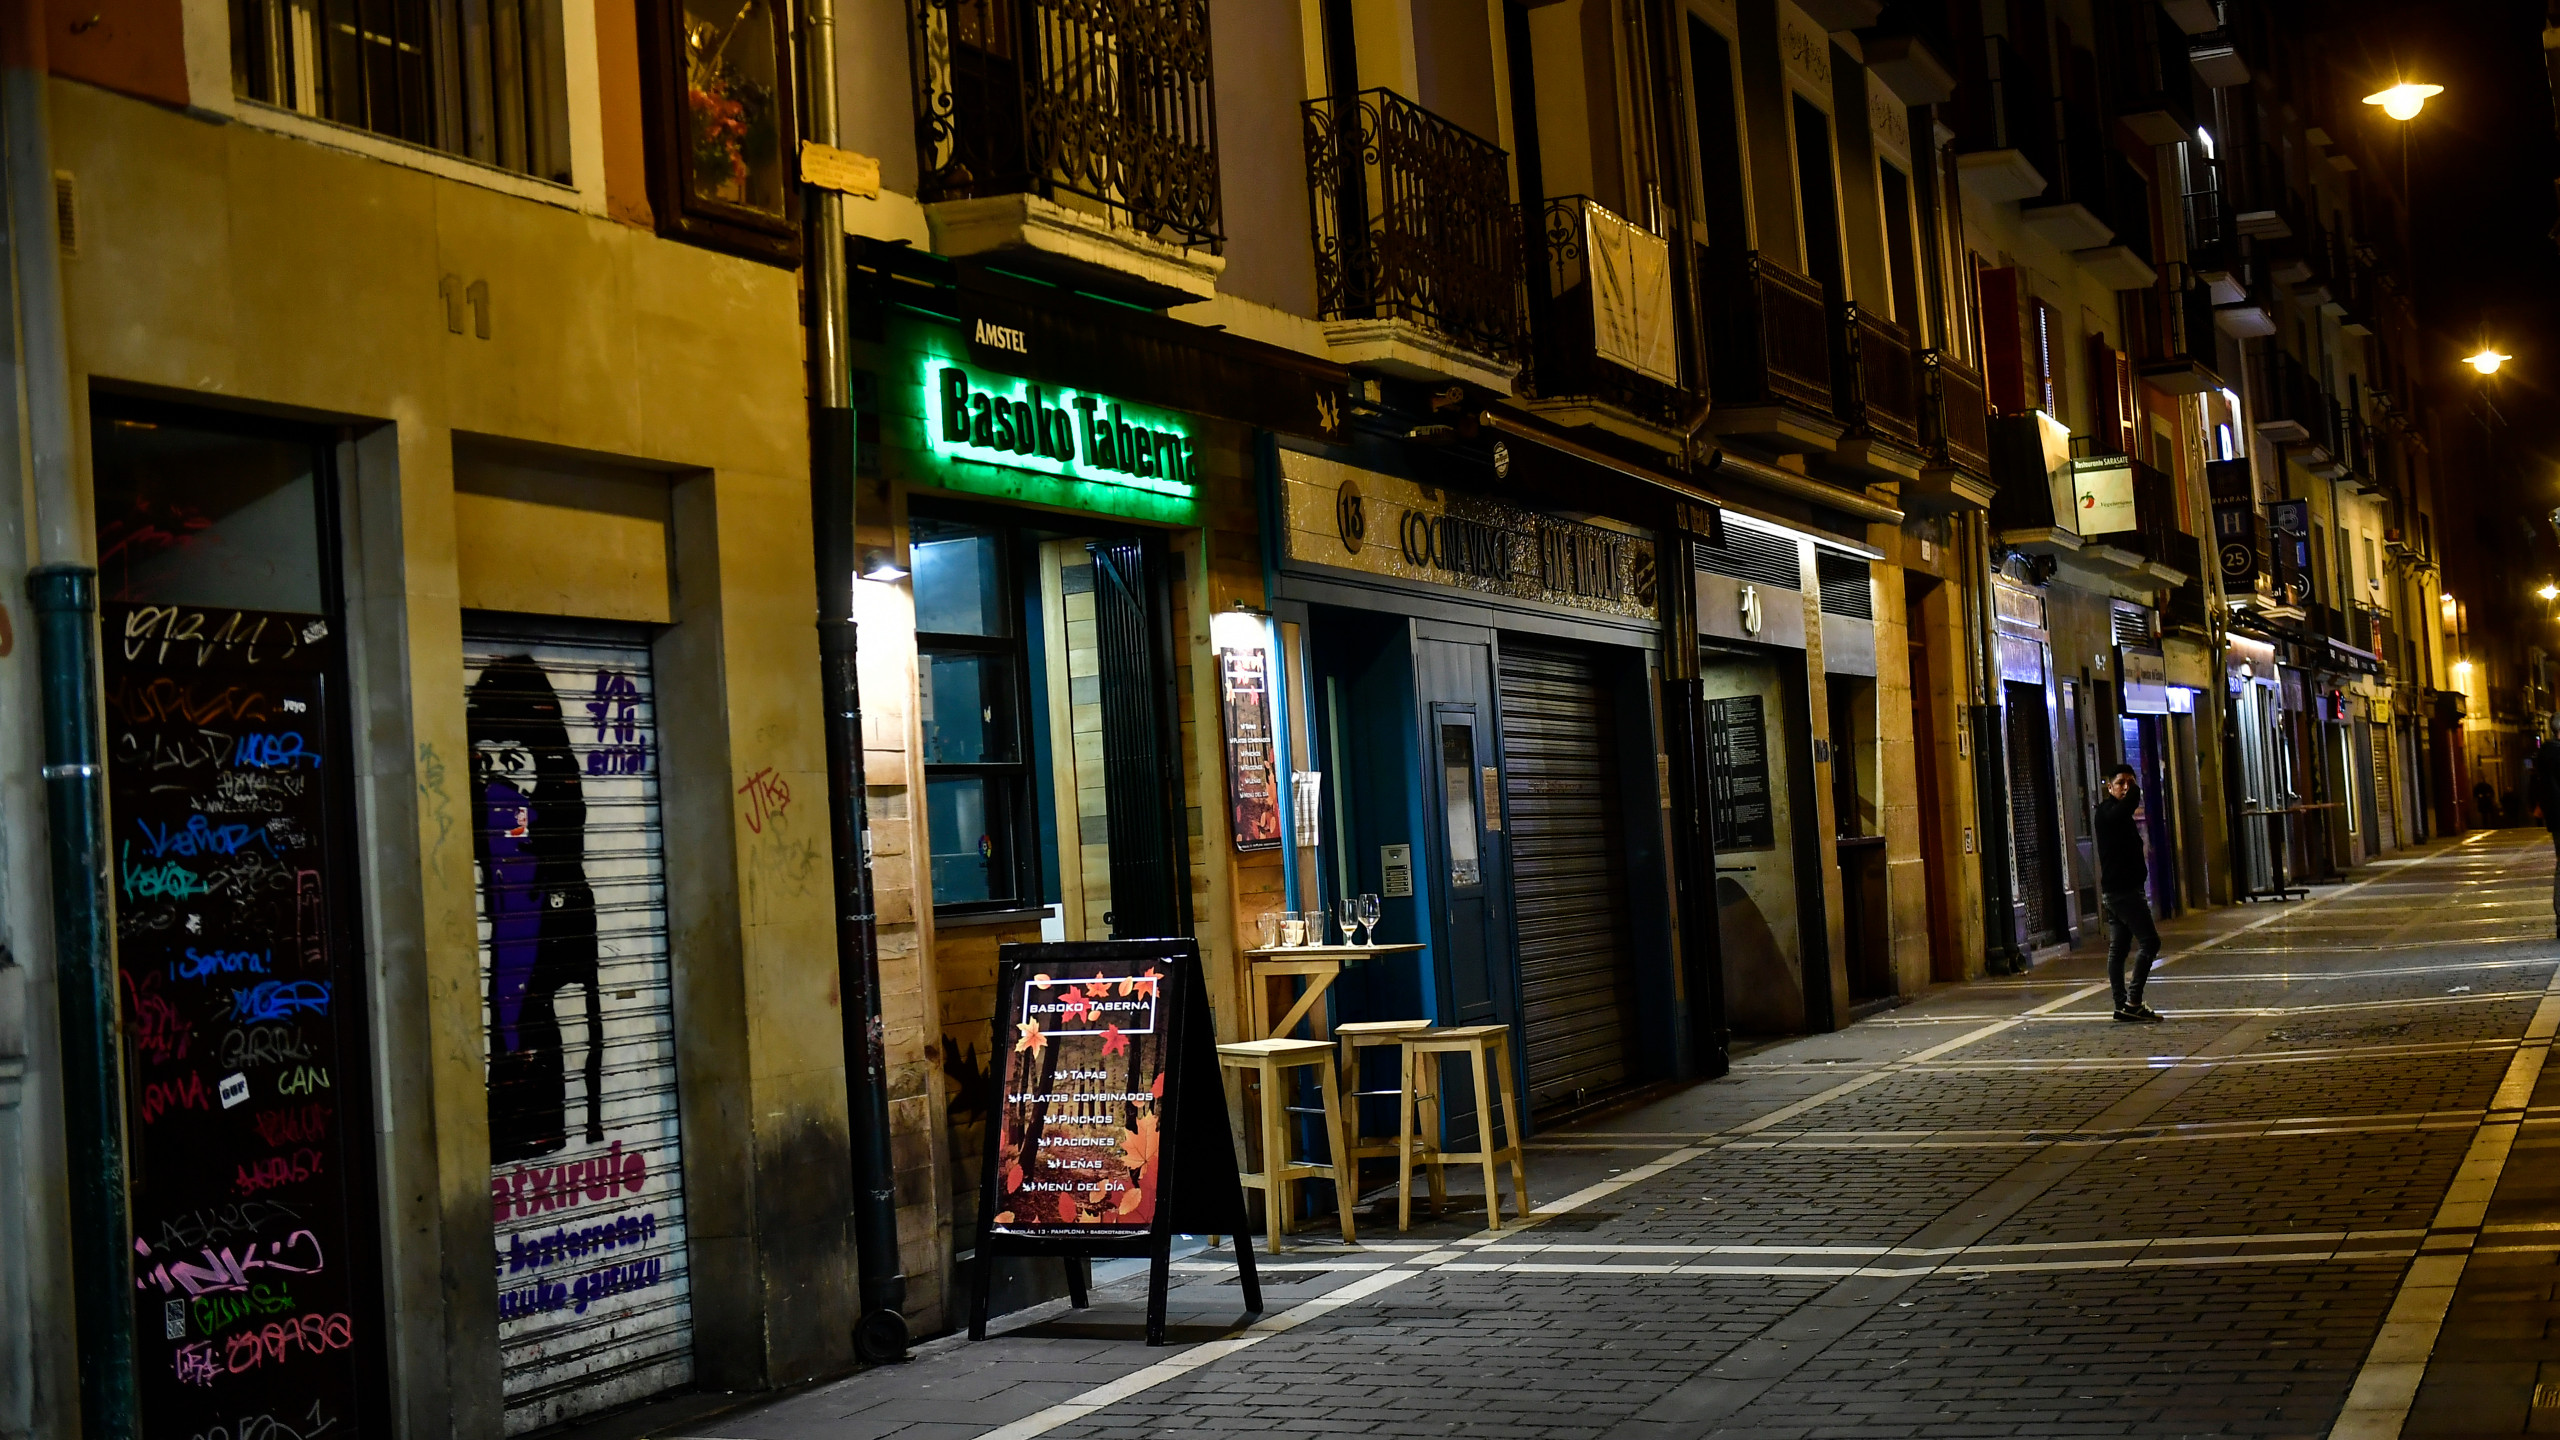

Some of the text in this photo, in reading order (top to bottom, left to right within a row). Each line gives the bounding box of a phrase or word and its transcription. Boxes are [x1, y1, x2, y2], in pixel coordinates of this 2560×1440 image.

[439, 273, 490, 340] 11
[975, 318, 1028, 354] AMSTEL
[939, 366, 1198, 486] Basoko Taberna
[1340, 494, 1364, 539] 13
[2225, 552, 2246, 568] 25
[1029, 1000, 1151, 1014] BASOKO TABERNA
[278, 1064, 331, 1096] CAN
[1070, 1070, 1108, 1081] TAPAS
[1022, 1091, 1154, 1103] PLATOS COMBINADOS
[1058, 1114, 1114, 1125] PINCHOS
[1053, 1136, 1115, 1147] RACIONES
[1062, 1158, 1103, 1170] LEÑAS
[1037, 1179, 1126, 1192] MENÚ DEL DÍA
